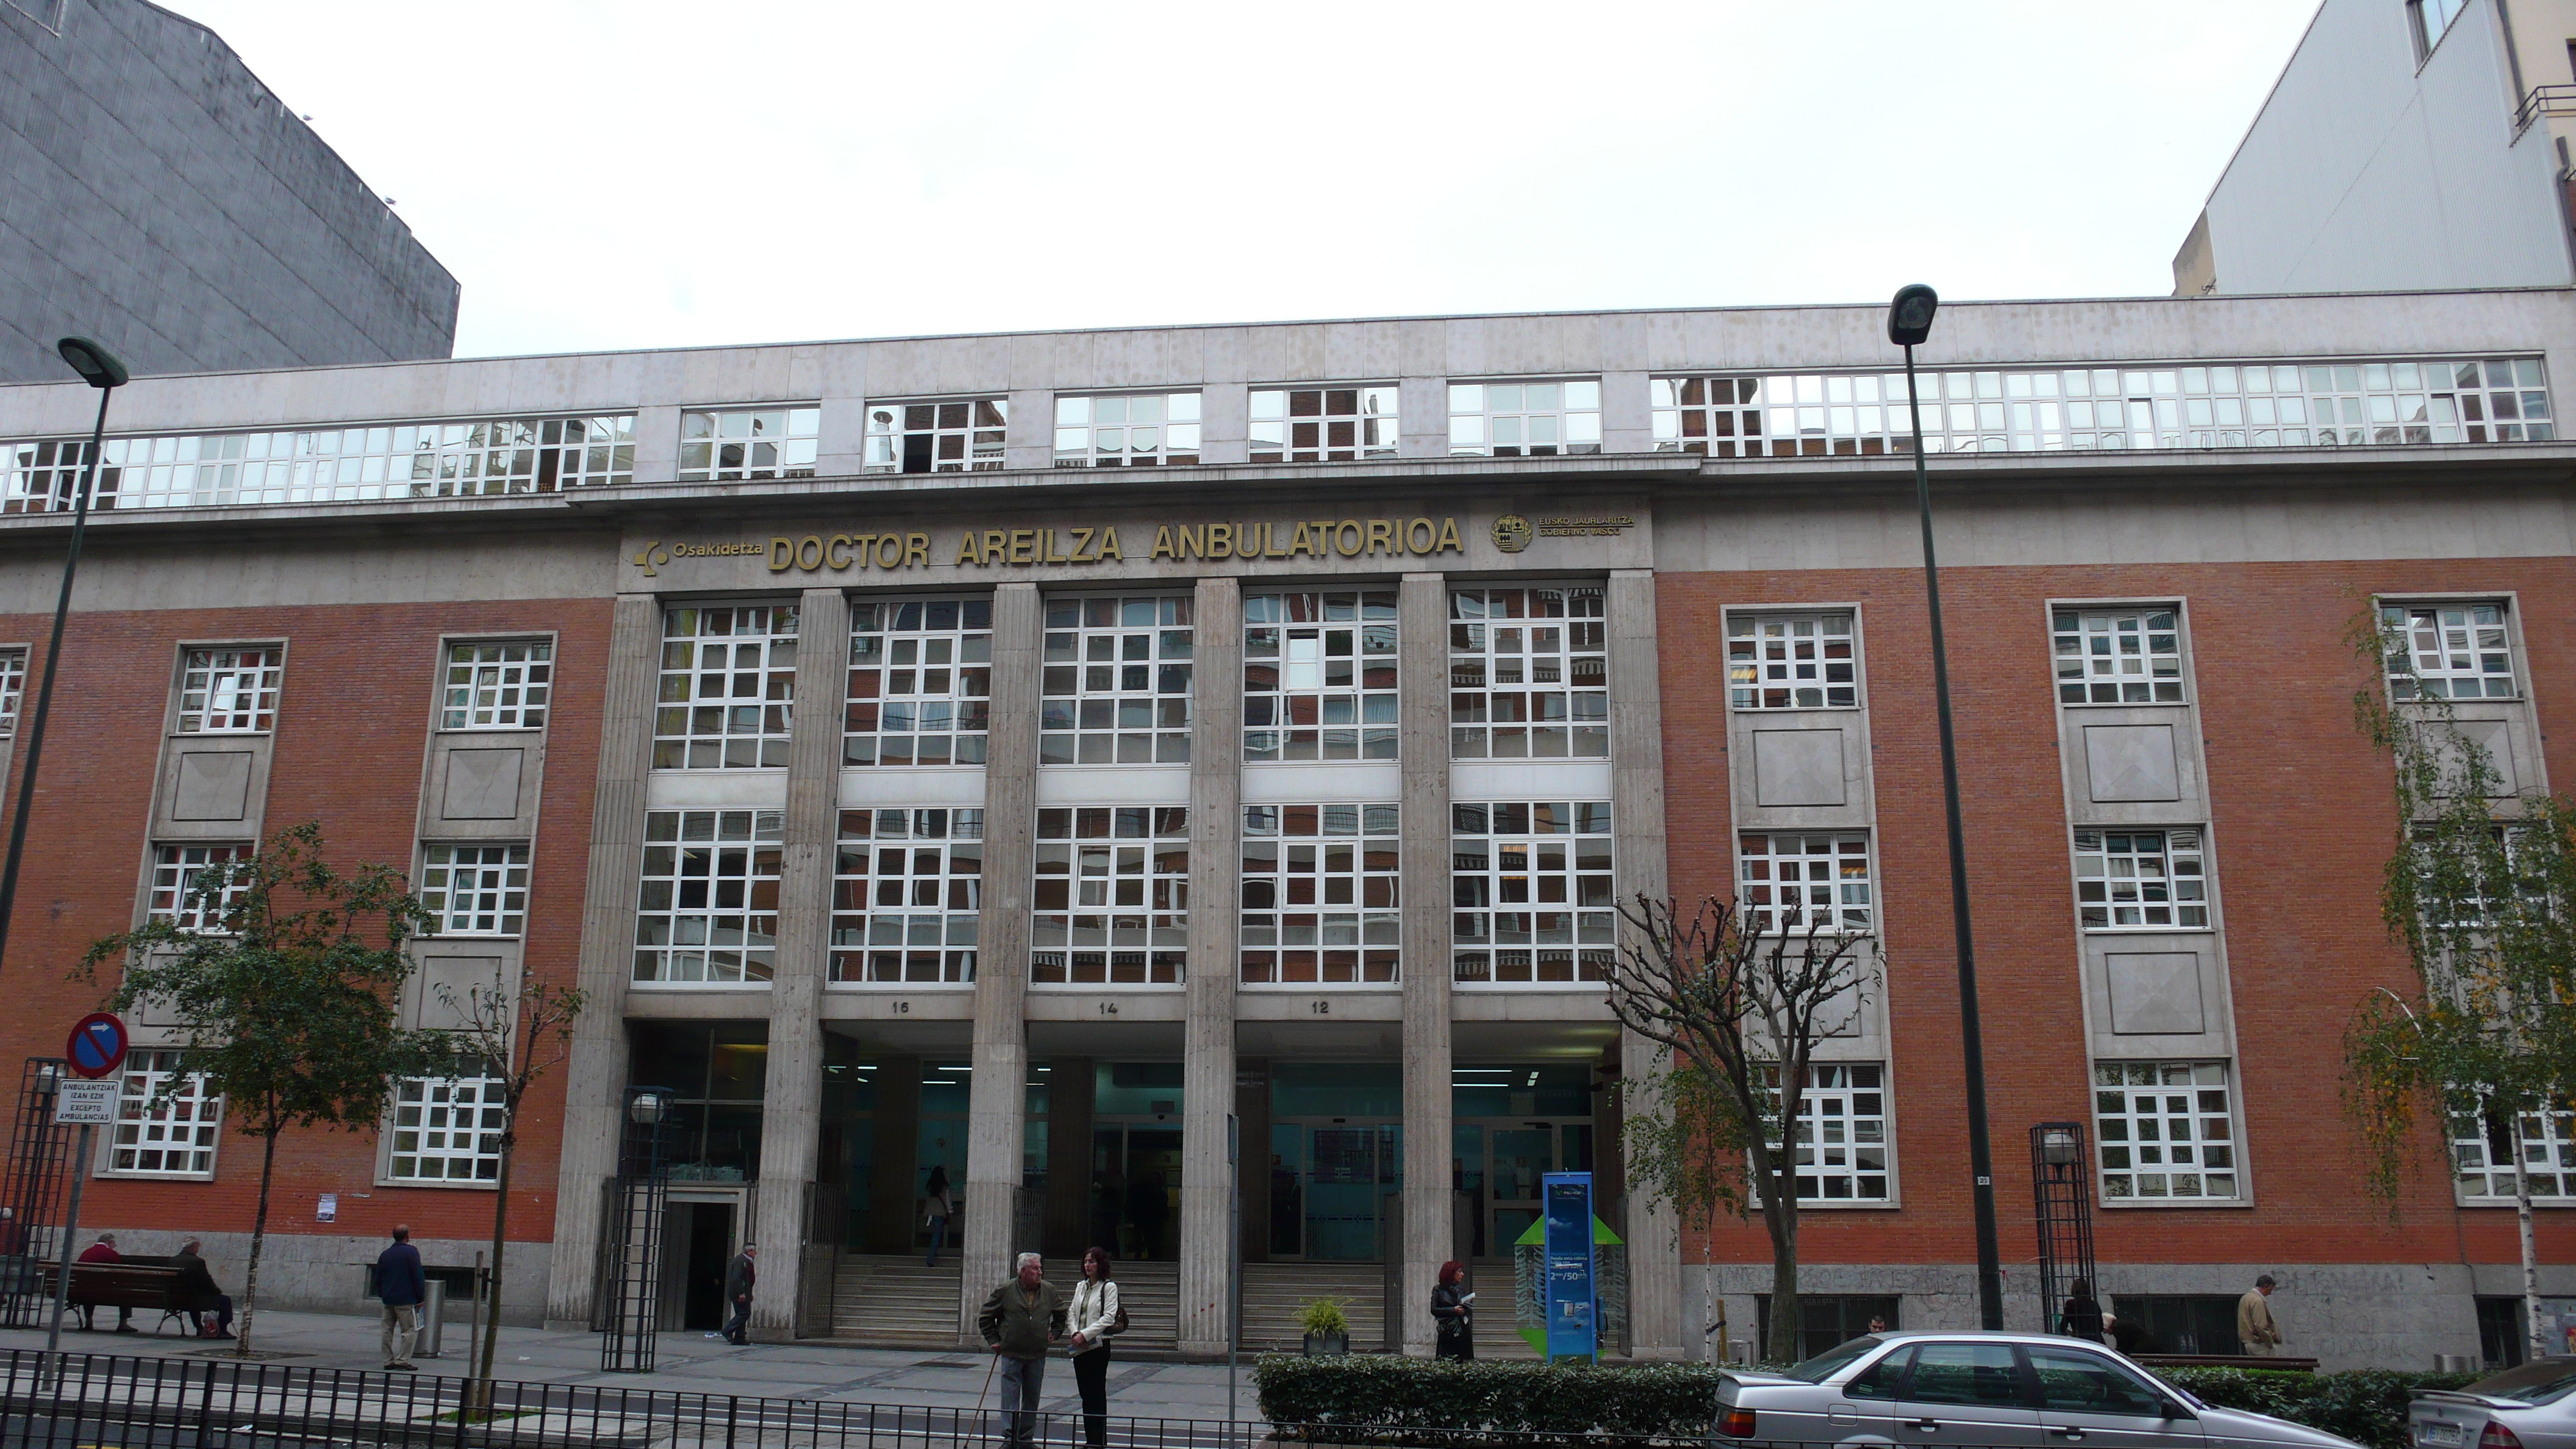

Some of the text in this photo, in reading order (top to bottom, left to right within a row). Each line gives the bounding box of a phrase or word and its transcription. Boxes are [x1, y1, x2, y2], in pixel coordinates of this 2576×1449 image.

[1539, 516, 1635, 526] EUSKO JAURLARITZA
[1539, 528, 1622, 537] GOBIERNO VASCO
[673, 542, 764, 557] Osakidetza
[768, 517, 1464, 571] DOCTOR AREILZA ANBULATORIOA
[893, 1001, 909, 1013] 16
[1100, 1002, 1118, 1014] 14
[1312, 1001, 1328, 1013] 12
